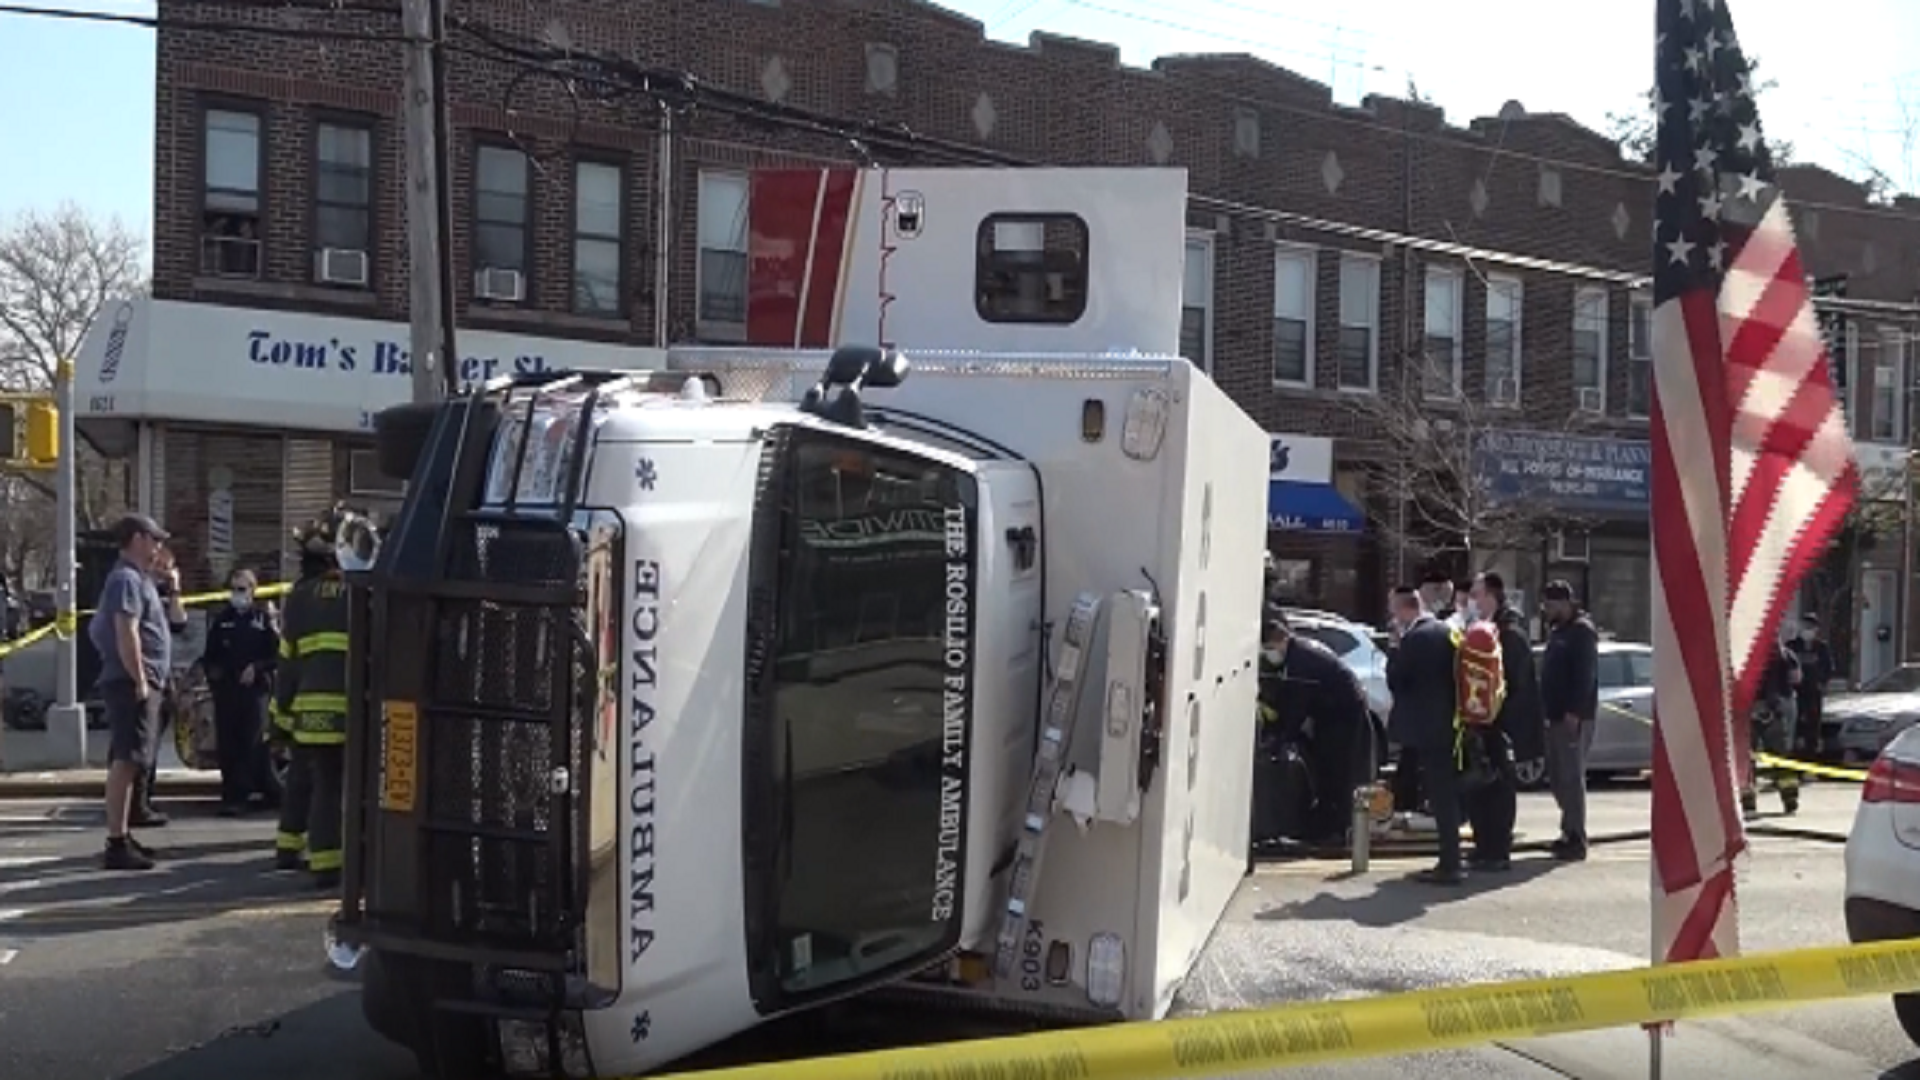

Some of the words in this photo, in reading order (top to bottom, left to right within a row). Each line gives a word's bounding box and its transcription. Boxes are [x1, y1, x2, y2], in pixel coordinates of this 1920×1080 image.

[248, 331, 357, 372] Tom's
[372, 340, 500, 381] Baer
[943, 503, 967, 557] THE
[942, 674, 965, 767] FAMILY
[931, 775, 963, 921] AMBULANCE
[1021, 919, 1045, 991] K903
